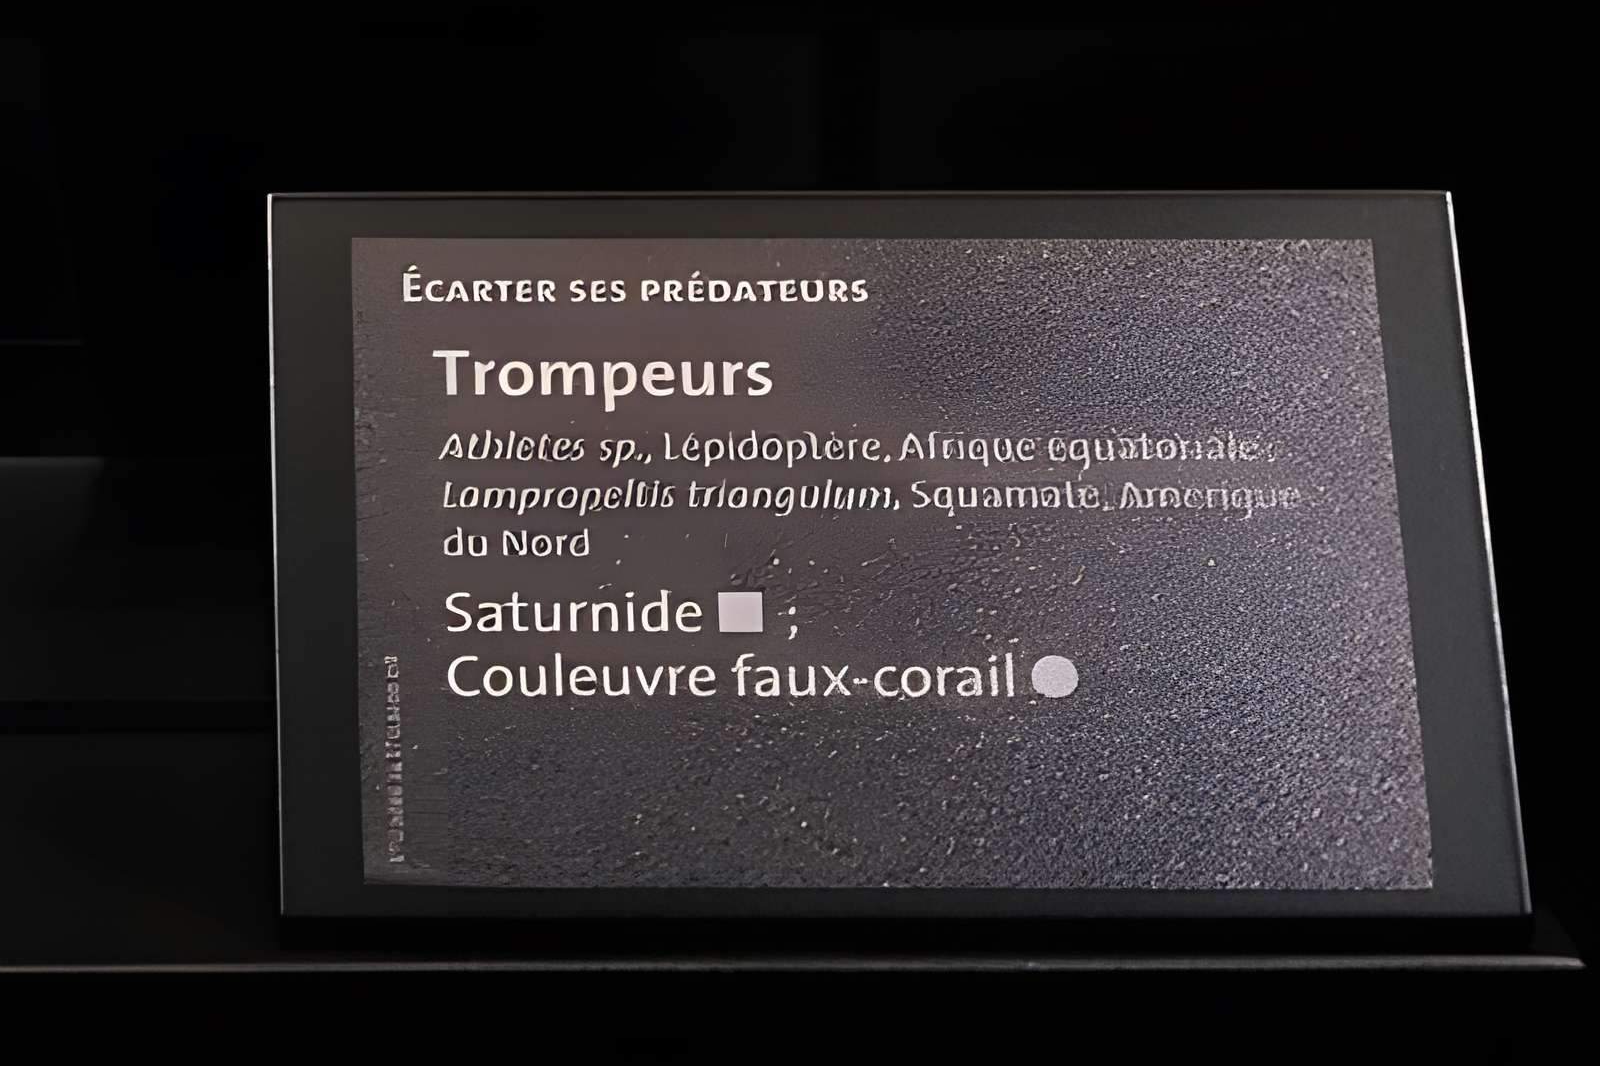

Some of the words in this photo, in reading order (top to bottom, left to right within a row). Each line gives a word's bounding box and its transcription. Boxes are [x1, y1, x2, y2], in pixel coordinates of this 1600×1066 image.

[402, 265, 556, 303] ÉCARTER
[569, 279, 626, 303] SES
[640, 270, 868, 303] PRÉDATEURS
[432, 349, 773, 412] Trompeurs
[687, 479, 901, 517] triangulum,
[443, 526, 489, 557] du
[501, 528, 591, 557] Nord
[444, 590, 703, 633] Saturnide
[446, 653, 717, 698] Couleuvre
[730, 652, 1016, 699] faux-corail
